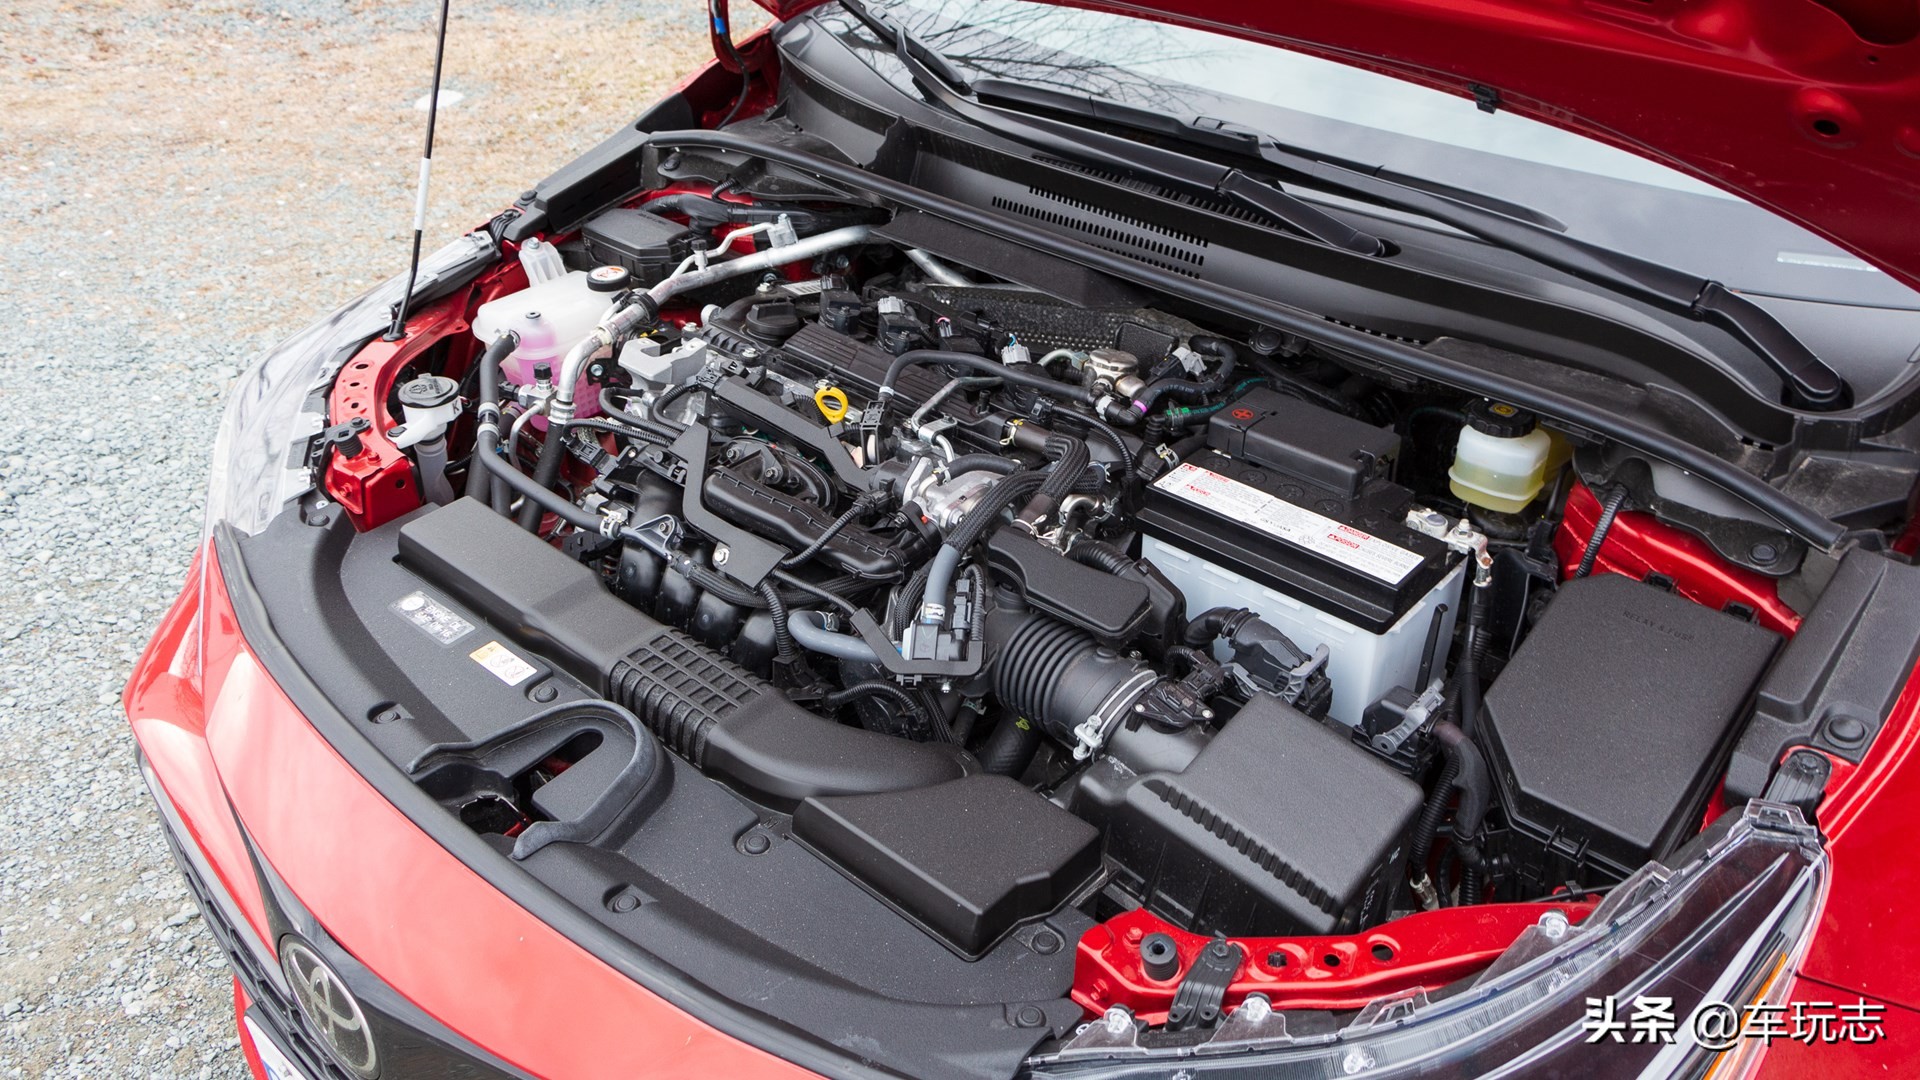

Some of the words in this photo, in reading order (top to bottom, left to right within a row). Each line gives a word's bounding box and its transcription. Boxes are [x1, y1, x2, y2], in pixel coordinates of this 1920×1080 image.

[452, 399, 460, 415] K
[1622, 611, 1655, 628] RELAY
[1666, 628, 1695, 642] FUSE
